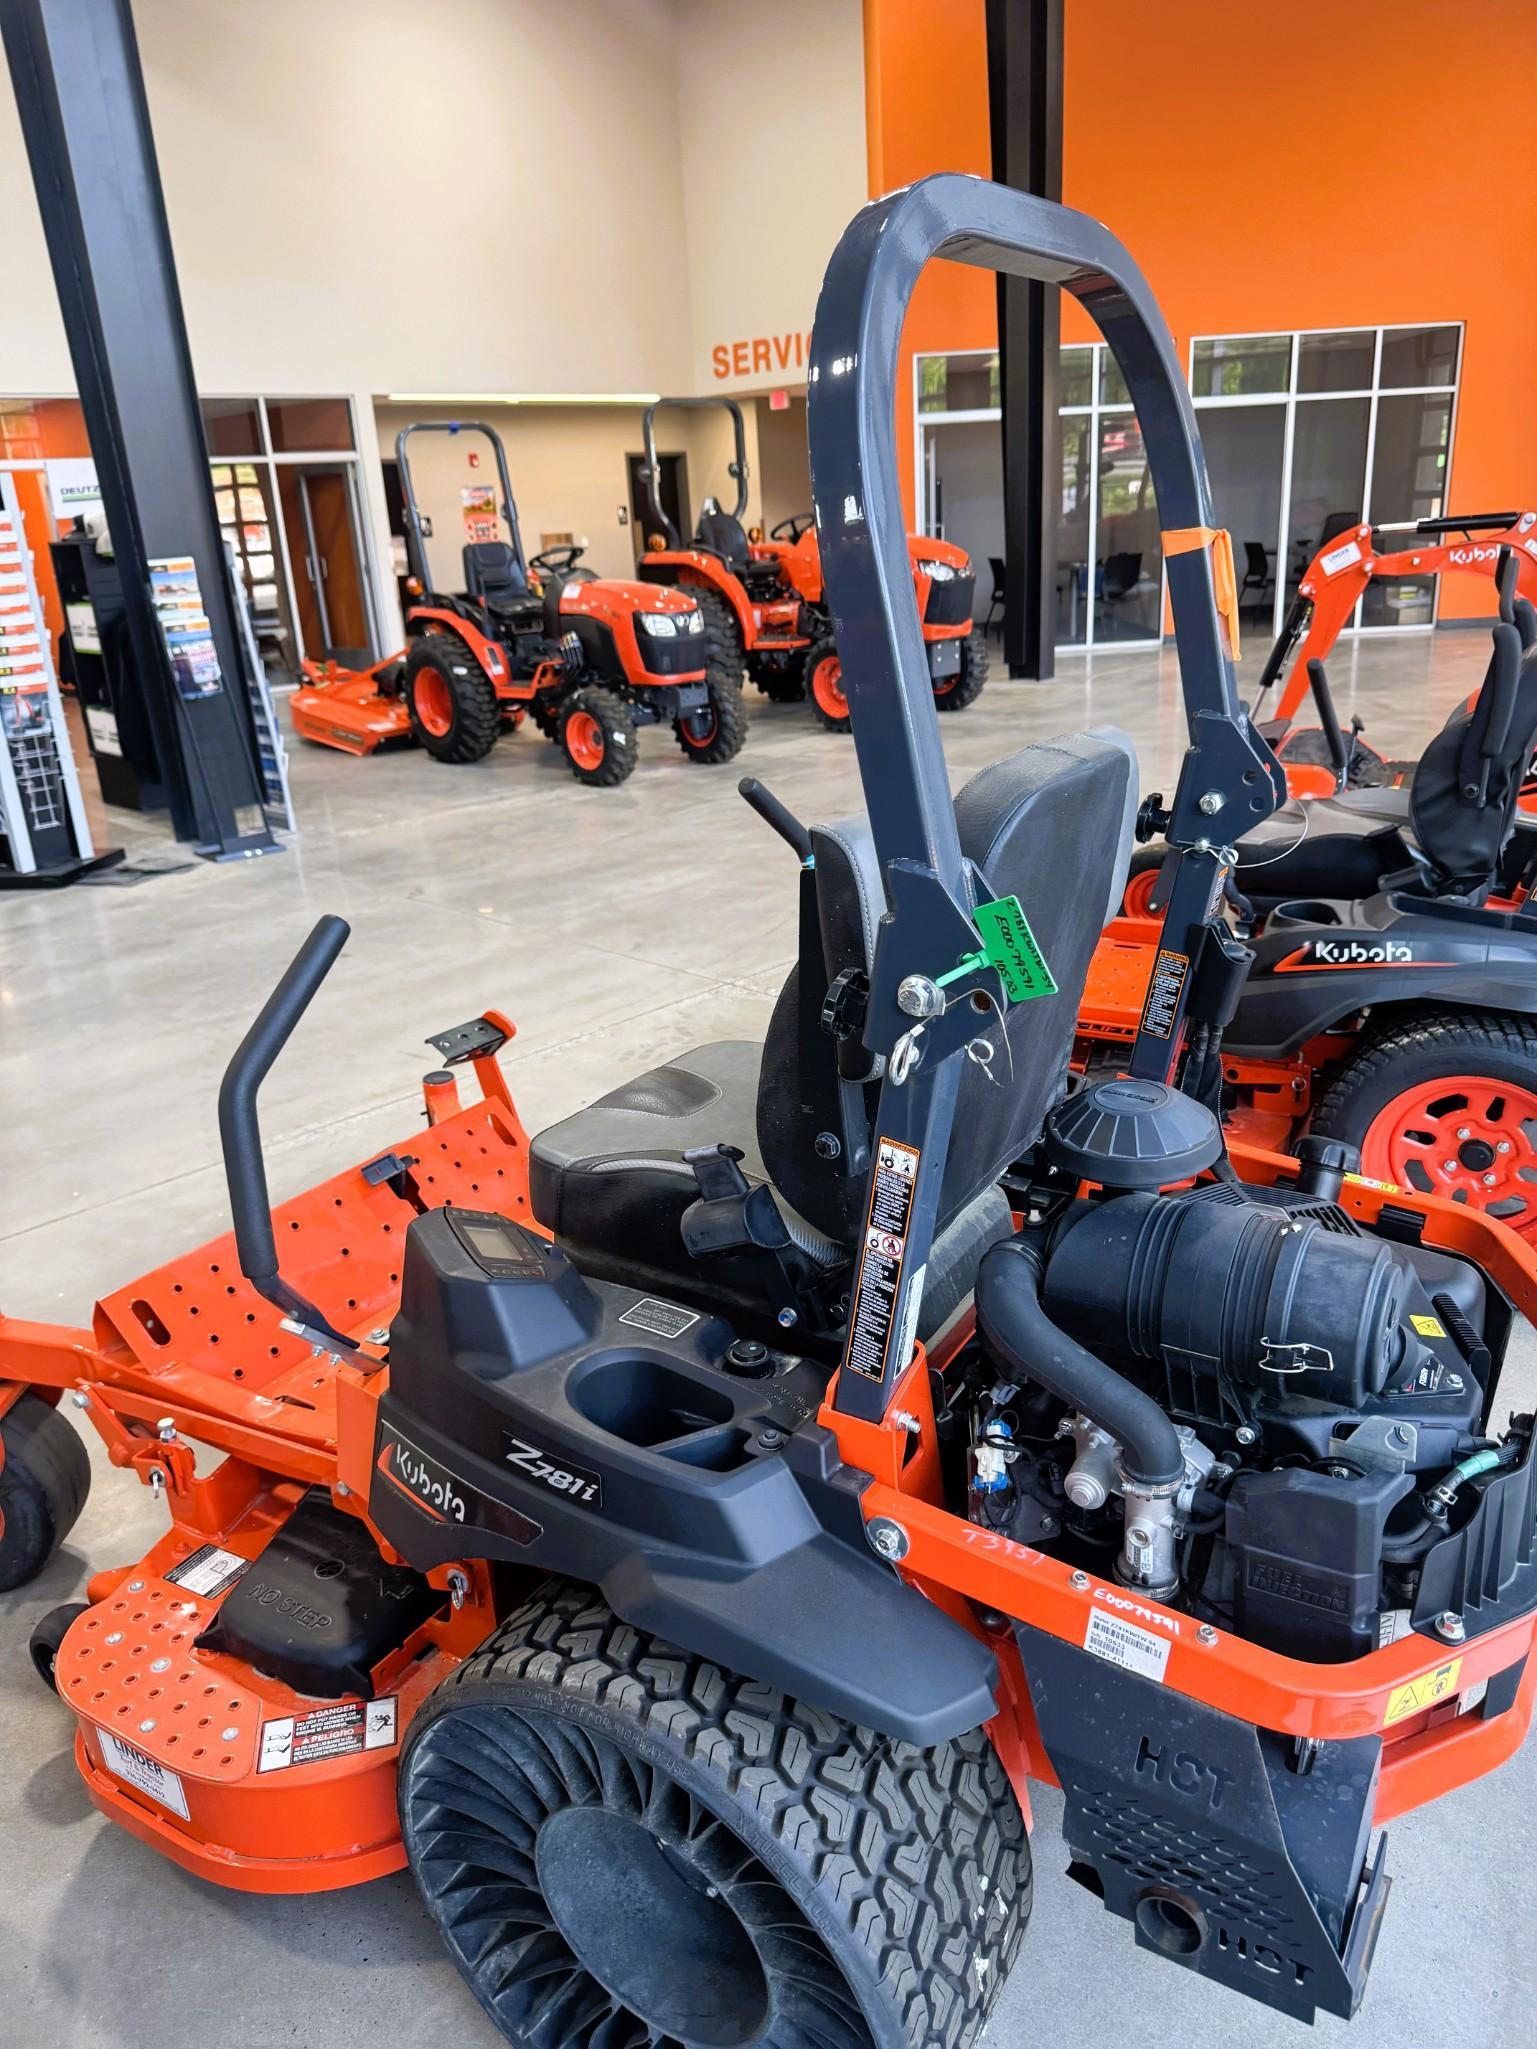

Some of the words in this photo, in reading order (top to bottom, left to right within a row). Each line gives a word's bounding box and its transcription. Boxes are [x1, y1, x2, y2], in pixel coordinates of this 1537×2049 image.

[712, 332, 812, 379] SERVI
[1316, 941, 1412, 963] Kubota
[396, 1443, 466, 1522] Kubota
[505, 1438, 599, 1501] Z781i
[1253, 1575, 1347, 1610] INJECTION
[1254, 1563, 1302, 1586] FUEL
[248, 1584, 281, 1605] NO
[277, 1598, 332, 1629] STEP
[314, 1704, 357, 1718] DANGER
[311, 1728, 355, 1743] PELIGRO
[112, 1736, 165, 1779] LINDER
[667, 1757, 692, 1780] USE
[1134, 1735, 1237, 1809] HOT
[1218, 1928, 1314, 1985] HOT
